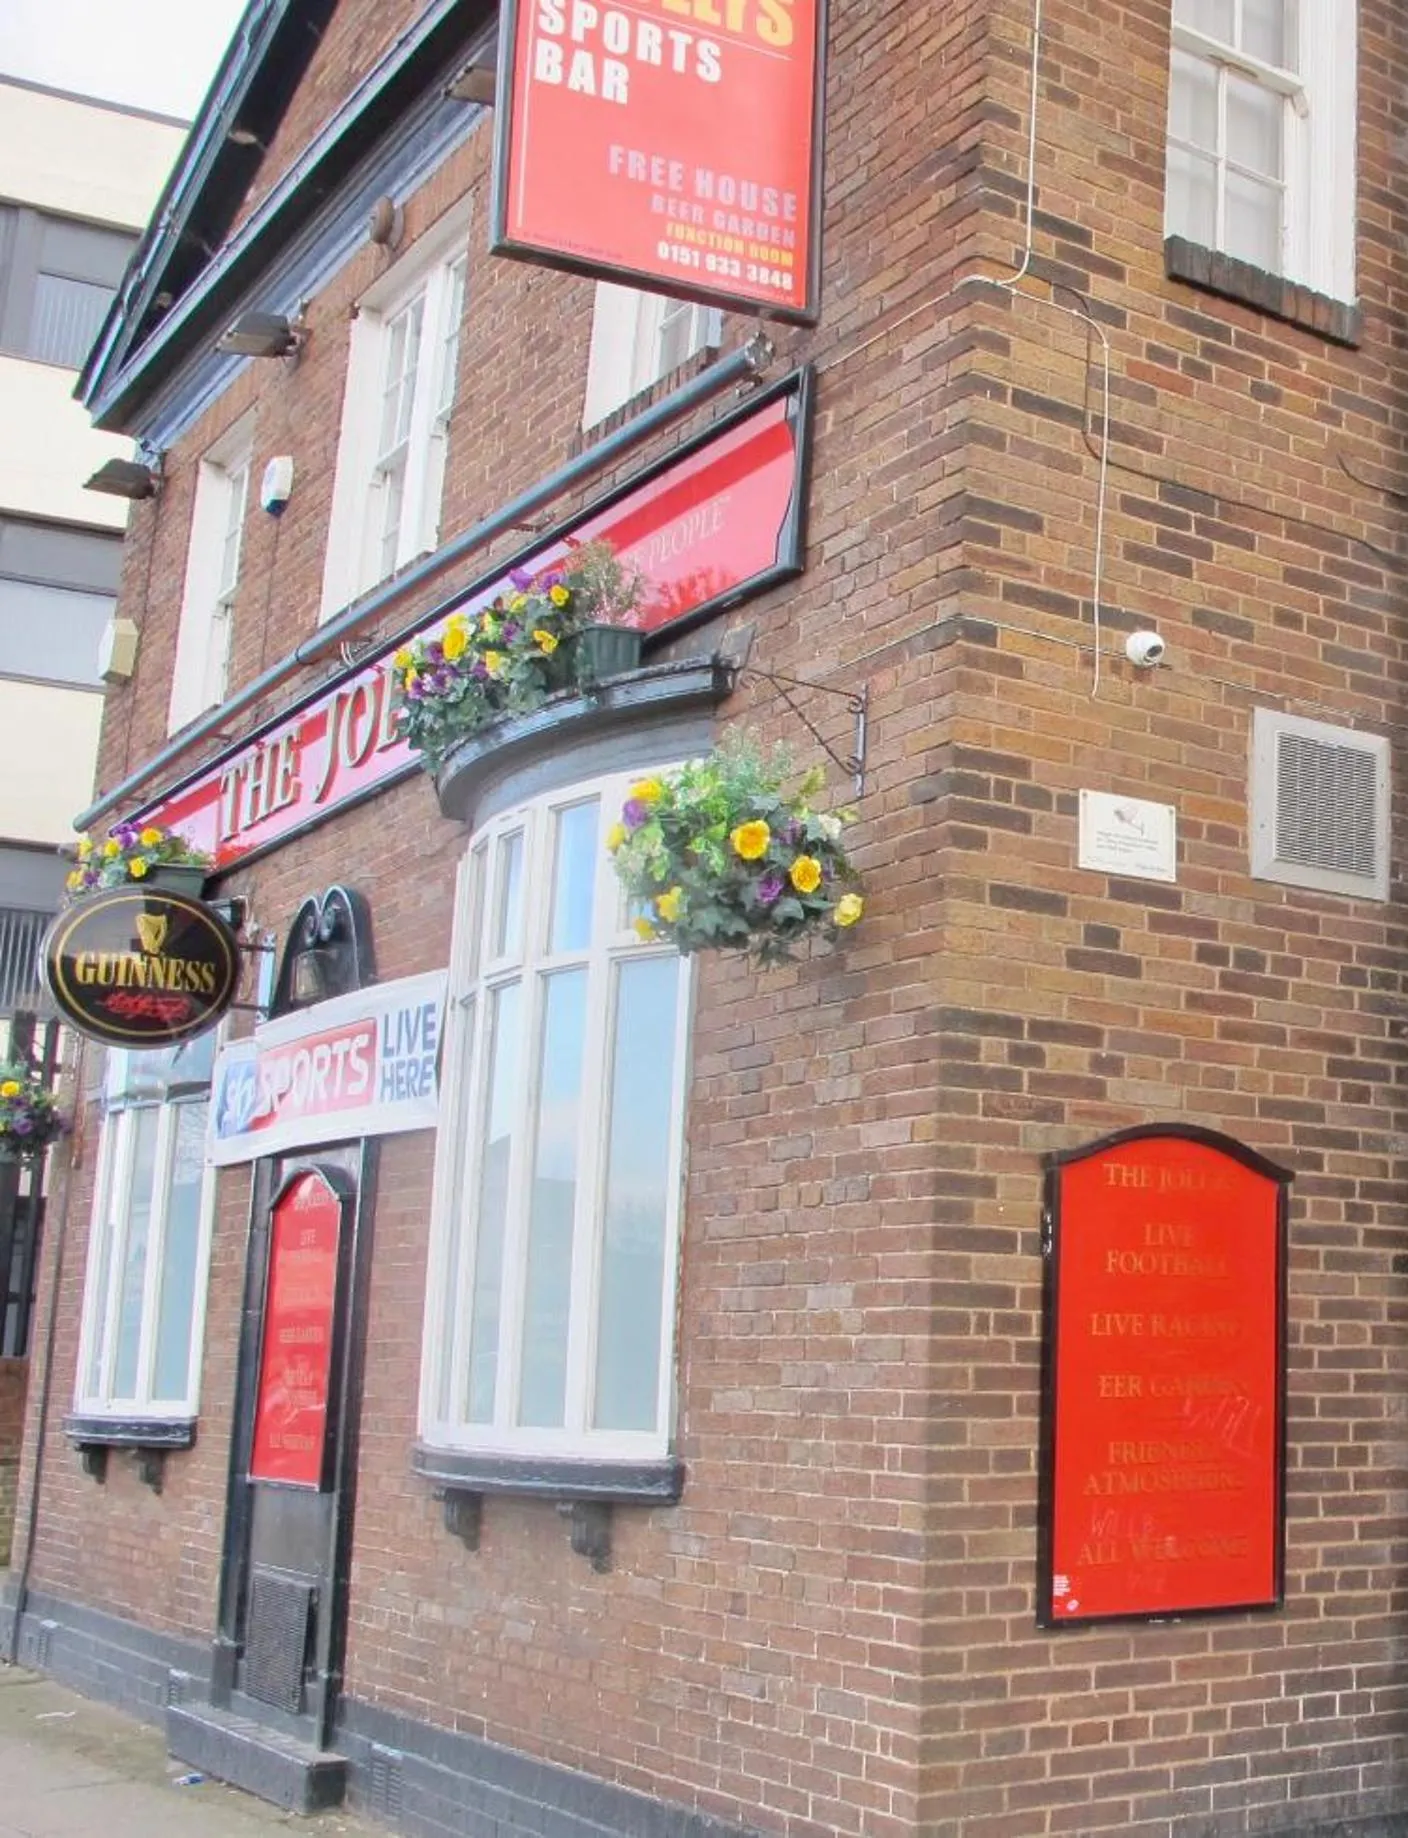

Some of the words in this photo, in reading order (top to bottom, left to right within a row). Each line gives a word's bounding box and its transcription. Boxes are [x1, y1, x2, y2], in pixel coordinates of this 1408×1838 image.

[538, 0, 722, 82] SPORTS
[534, 39, 629, 104] BAR
[608, 144, 684, 192] FREE
[695, 165, 797, 222] HOUSE
[651, 193, 704, 225] BEER
[713, 209, 795, 249] GARDEN
[666, 220, 744, 255] FUNCTION
[657, 240, 700, 268] 0151
[220, 724, 302, 843] THE
[314, 668, 408, 804] JOL
[75, 950, 217, 993] GUINNESS
[384, 1003, 437, 1058] LIVE
[381, 1056, 435, 1104] HERE
[1102, 1162, 1152, 1188] THE
[1089, 1312, 1144, 1337] LIVE
